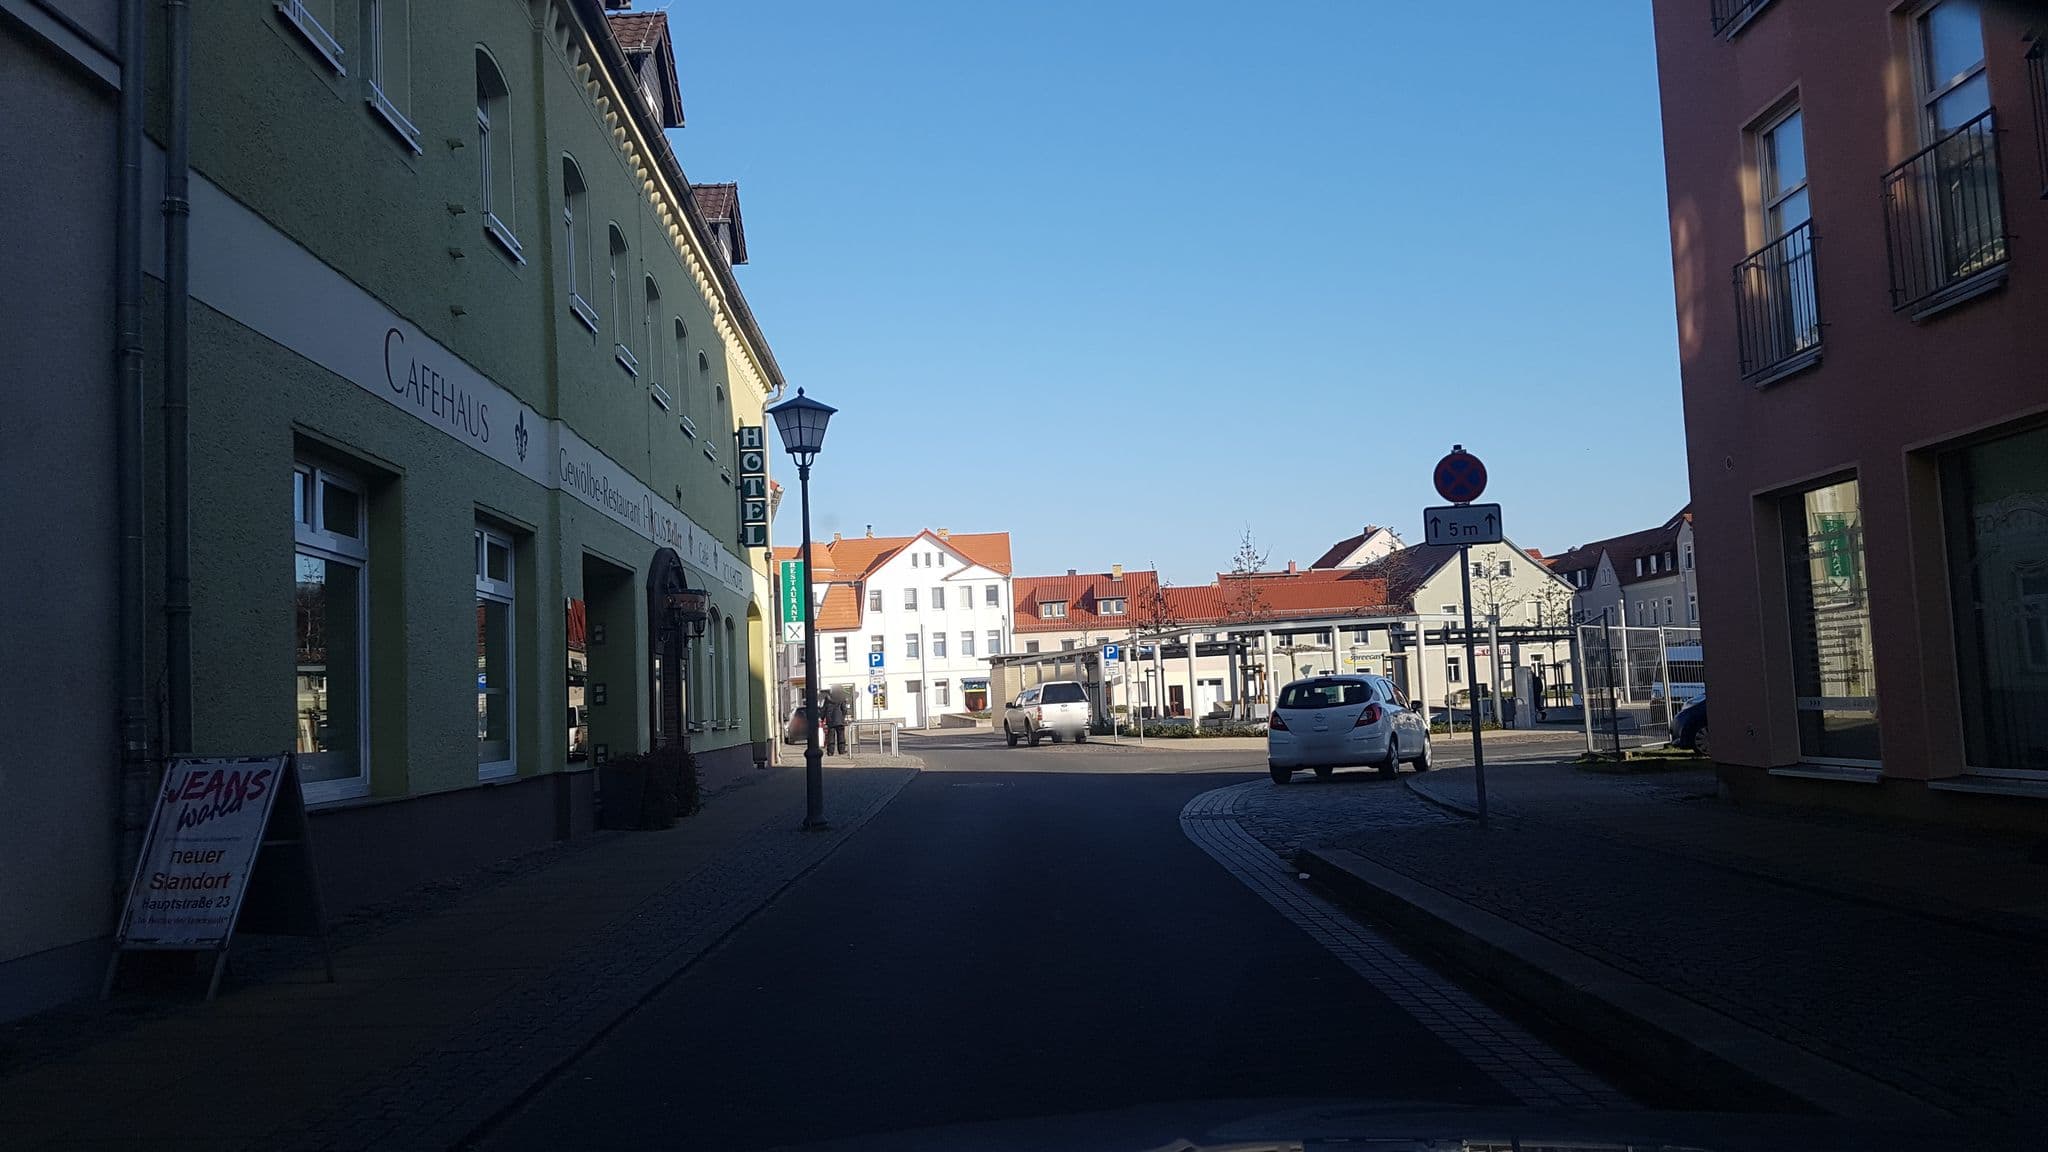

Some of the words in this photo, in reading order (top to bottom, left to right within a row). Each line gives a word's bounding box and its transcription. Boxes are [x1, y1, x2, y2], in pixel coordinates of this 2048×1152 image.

[384, 328, 489, 443] CAFEHAUS
[742, 428, 765, 545] HOTEL
[1449, 522, 1458, 537] 5
[1463, 525, 1478, 536] m
[789, 562, 798, 621] RESTAURANT
[871, 654, 881, 666] P
[1106, 646, 1115, 658] P
[168, 769, 272, 803] JEANS
[169, 848, 226, 864] neuer
[150, 872, 232, 890] Standort
[215, 895, 231, 909] 23
